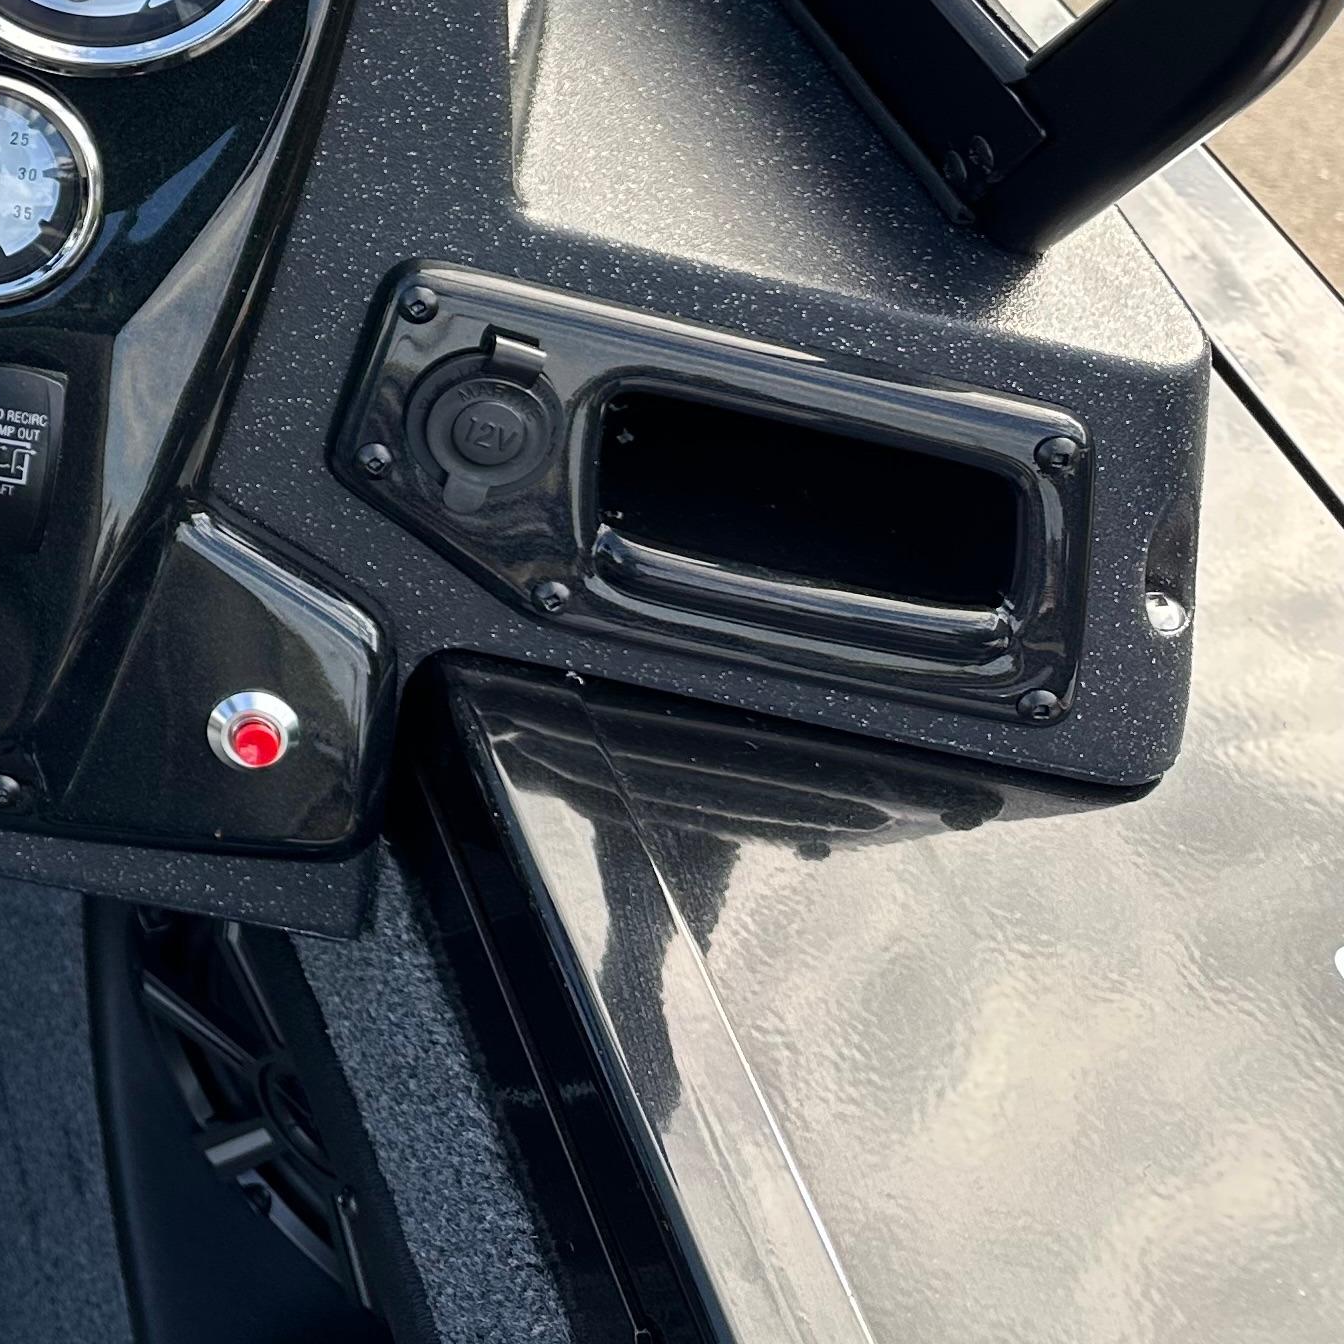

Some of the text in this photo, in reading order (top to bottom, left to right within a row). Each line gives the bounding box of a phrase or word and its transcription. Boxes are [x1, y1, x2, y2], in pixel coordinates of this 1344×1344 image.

[10, 132, 30, 147] 25
[17, 167, 37, 182] 30
[13, 205, 32, 220] 35
[6, 409, 48, 428] RECIRC
[17, 425, 41, 441] OUT
[464, 416, 519, 452] 12V
